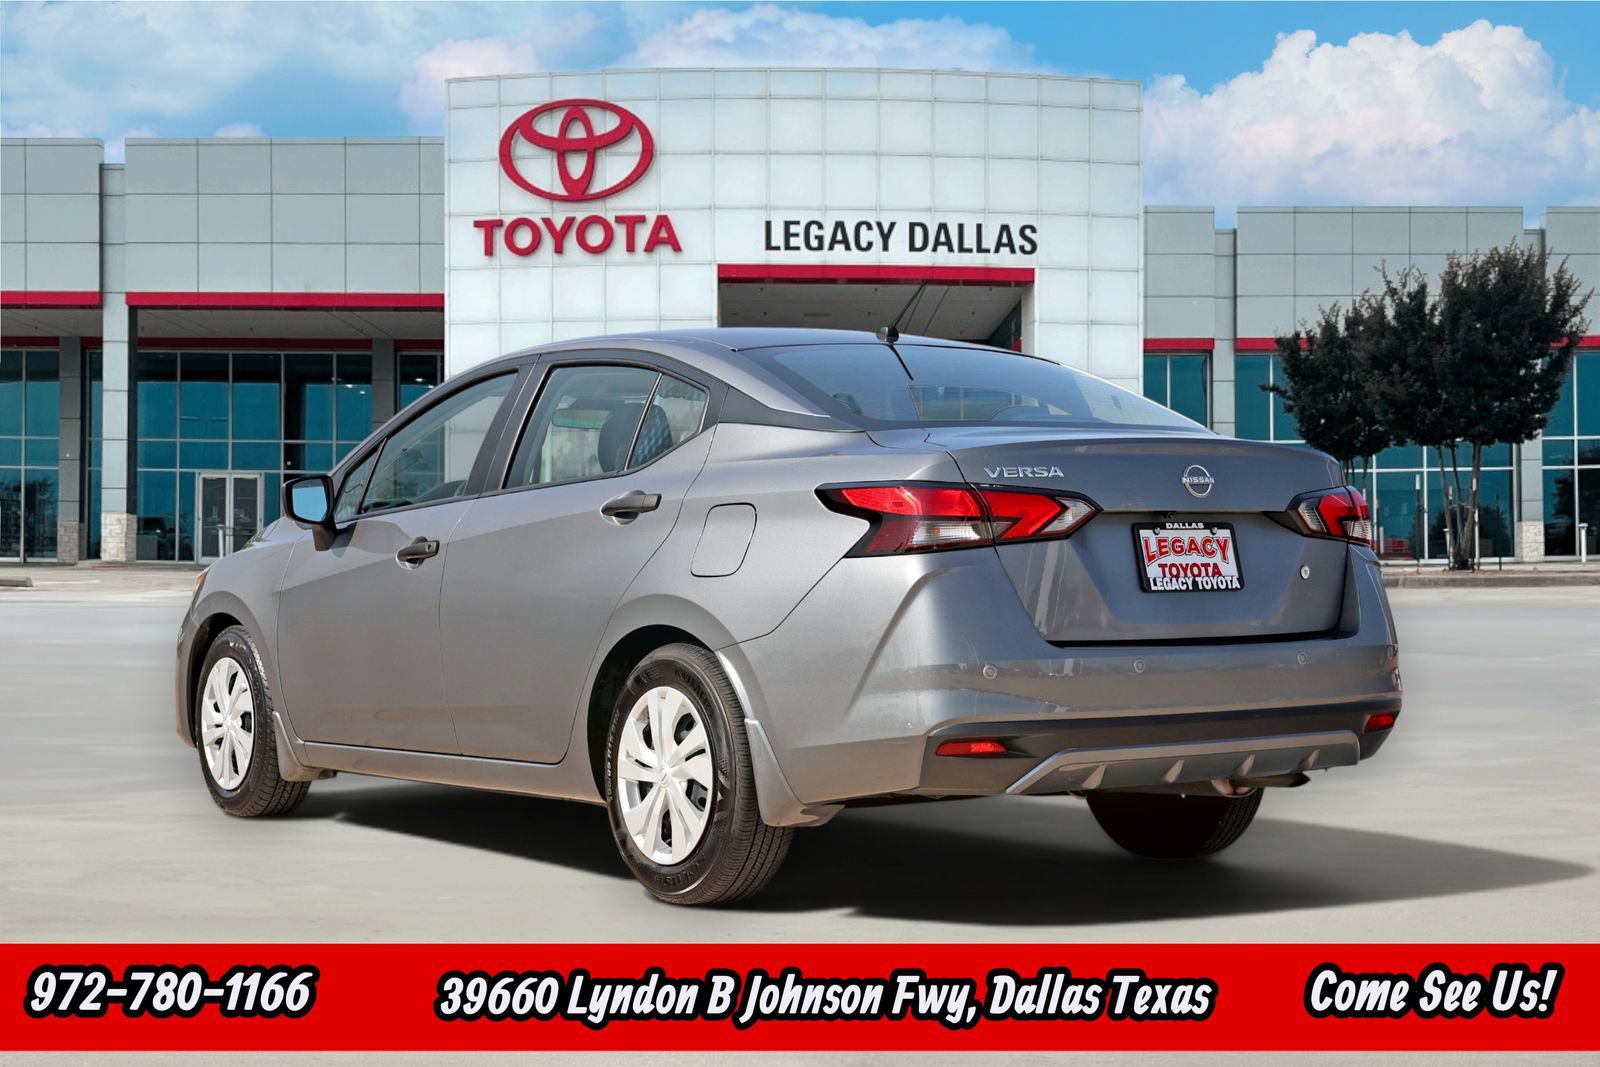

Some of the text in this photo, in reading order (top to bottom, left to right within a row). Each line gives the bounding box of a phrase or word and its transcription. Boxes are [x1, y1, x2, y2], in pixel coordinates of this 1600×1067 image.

[474, 214, 682, 257] TOYOTA
[764, 220, 1038, 255] LEGACY DALLAS
[984, 466, 1065, 479] VERSA
[1181, 475, 1215, 485] NISSAN
[1165, 522, 1205, 530] DALLAS
[1142, 536, 1230, 566] LEGACY
[1158, 562, 1223, 578] TOYOTA
[1149, 576, 1241, 591] LEGACY TOYOTA
